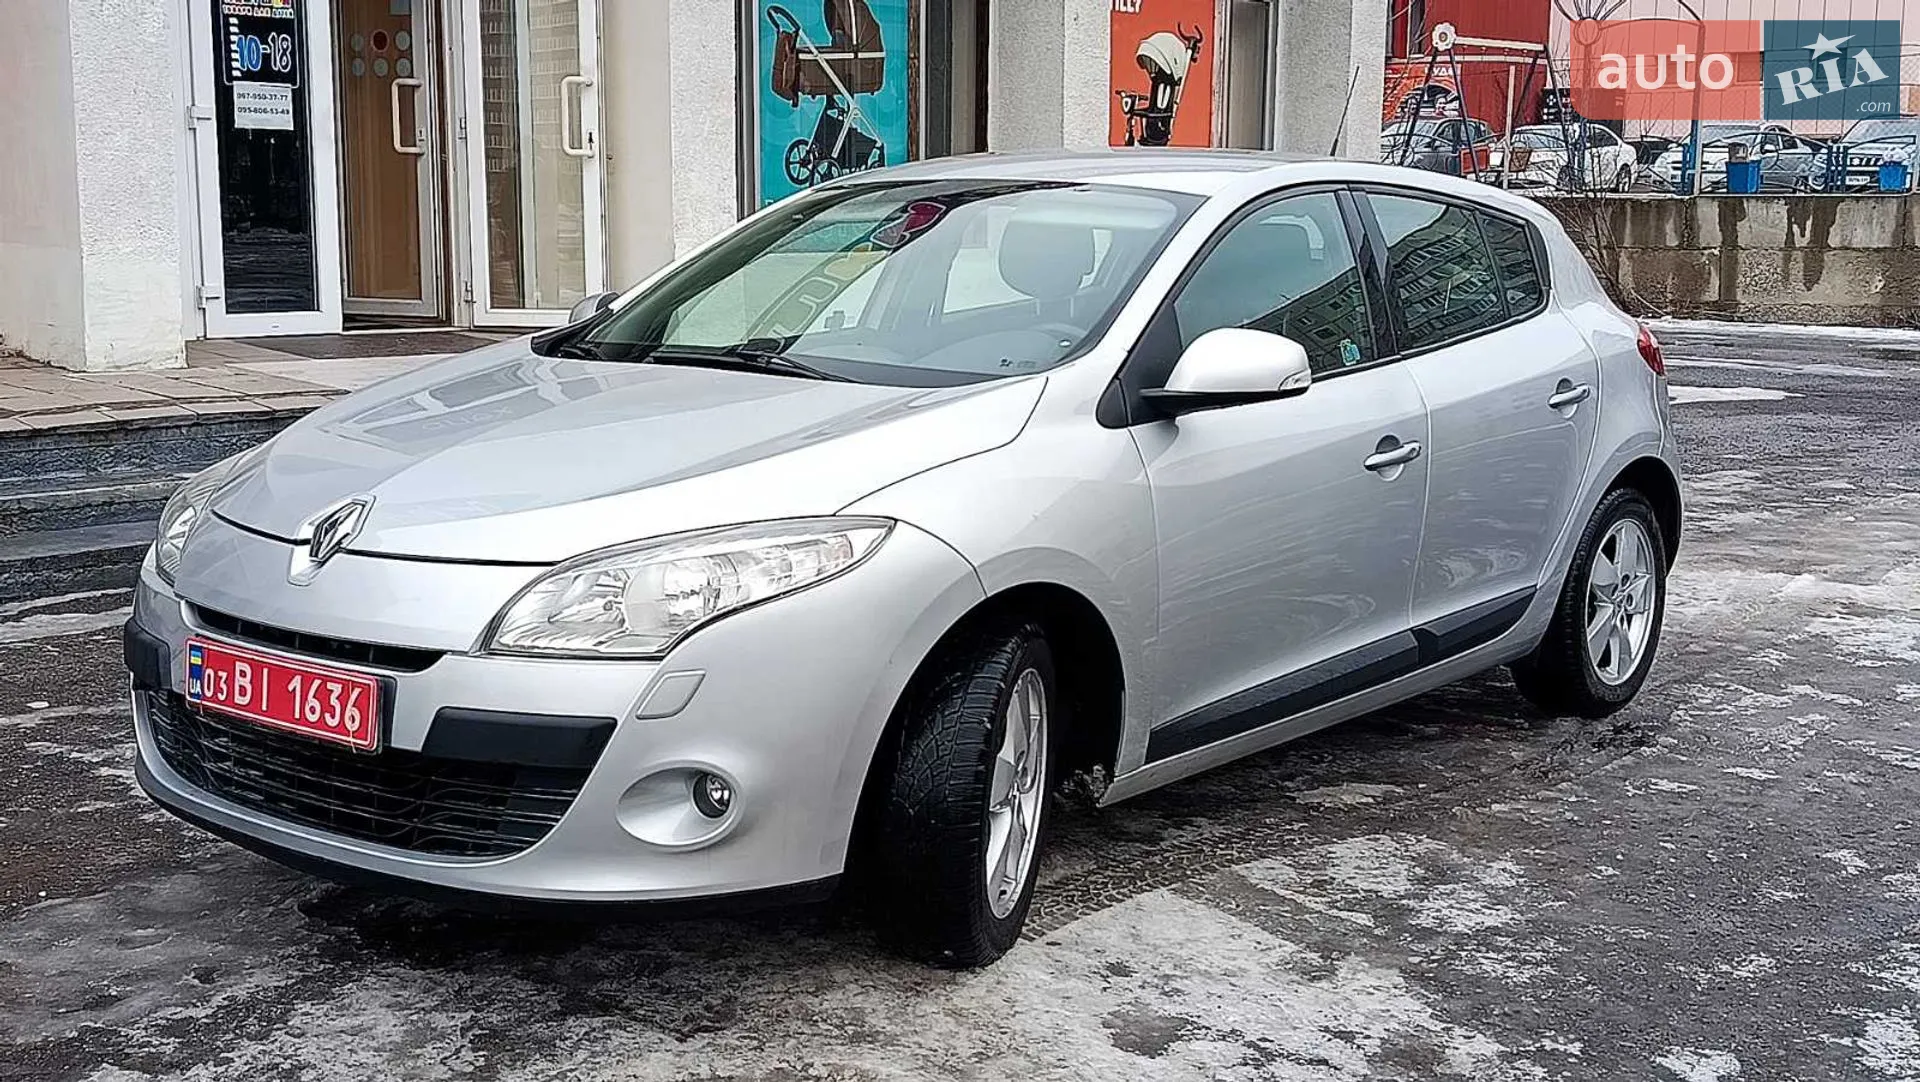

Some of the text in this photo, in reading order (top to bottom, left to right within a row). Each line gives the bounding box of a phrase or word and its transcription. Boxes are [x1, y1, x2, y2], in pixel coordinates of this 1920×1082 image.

[236, 31, 292, 73] 10-18
[189, 679, 202, 695] UA
[287, 675, 361, 732] 1636
